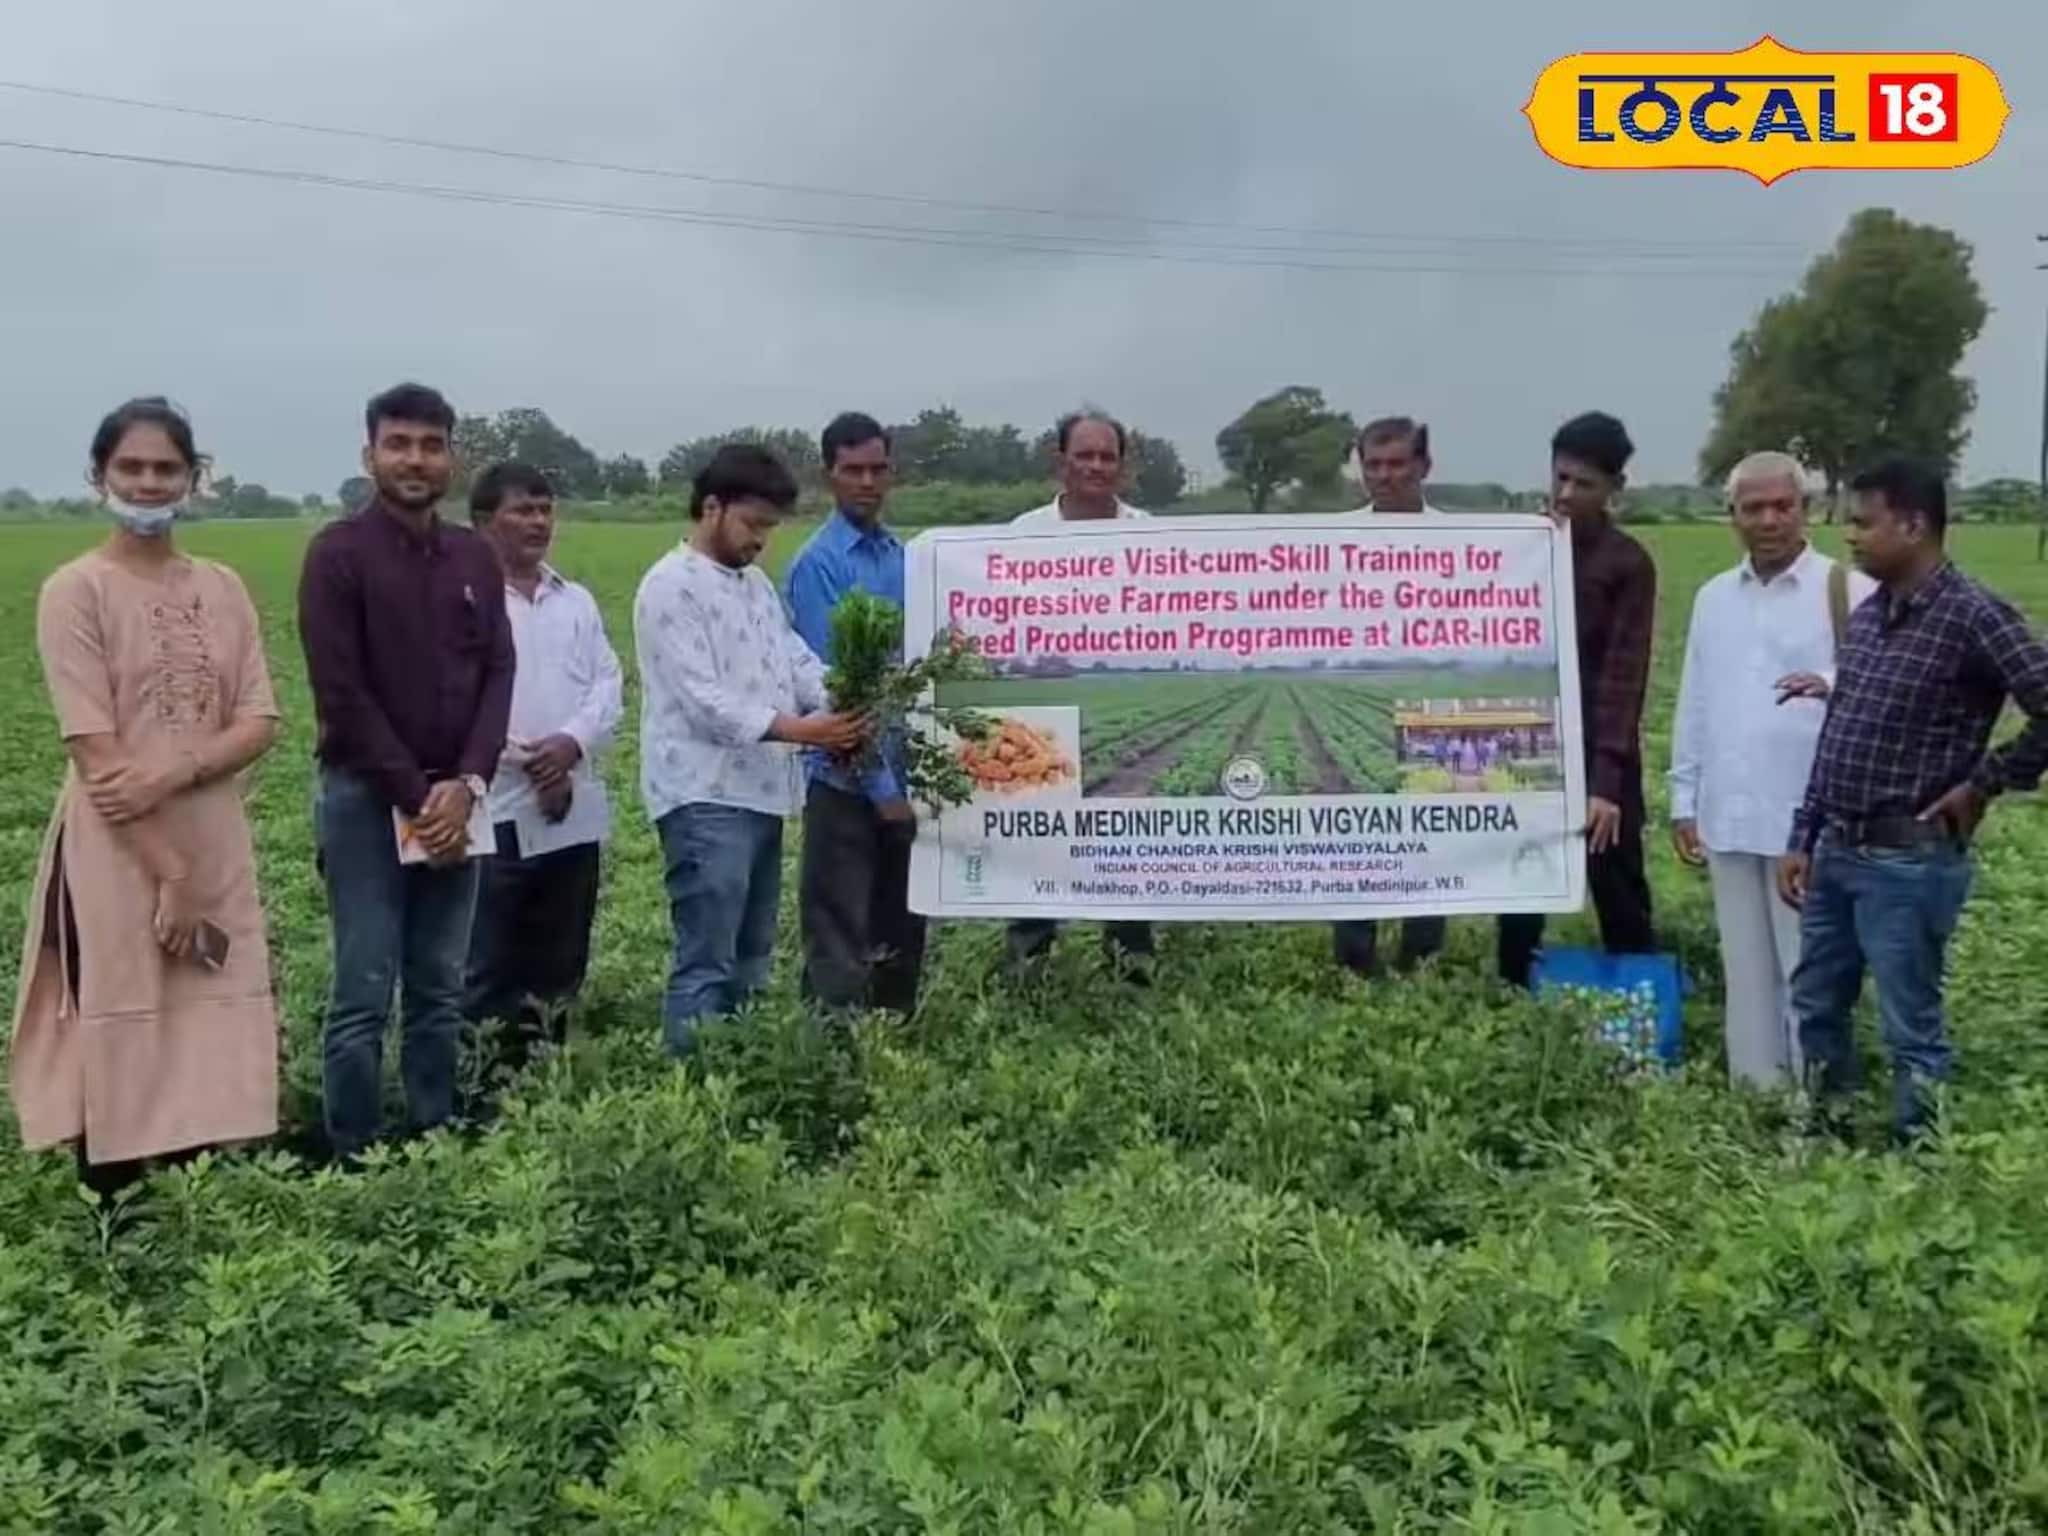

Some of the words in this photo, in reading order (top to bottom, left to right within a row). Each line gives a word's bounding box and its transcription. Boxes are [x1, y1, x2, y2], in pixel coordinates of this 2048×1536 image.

[986, 553, 1115, 585] Exposure
[1124, 545, 1330, 577] Visit-cum-Skill
[1339, 544, 1455, 578] Training
[1465, 545, 1503, 572] for
[949, 587, 1112, 624] Progressive
[1121, 586, 1239, 613] Farmers
[1249, 582, 1329, 611] under
[1340, 582, 1384, 609] the
[1394, 581, 1542, 609] Groundnut
[1026, 624, 1178, 653] Production
[1188, 621, 1353, 656] Programme
[1364, 621, 1390, 647] at
[1402, 617, 1541, 646] ICAR-IIGR
[983, 809, 1067, 838] PURBA
[1074, 808, 1211, 838] MEDINIPUR
[1219, 807, 1301, 836] KRISHI
[1309, 806, 1402, 835] VIGYAN
[1412, 805, 1518, 832] KENDRA
[1070, 844, 1132, 858] BIDHAN
[1136, 843, 1219, 857] CHANDRA
[1223, 843, 1279, 856] KRISHI
[1284, 841, 1428, 855] VISWAVIDYALAYA
[1093, 862, 1138, 874] INDIAN
[1140, 862, 1198, 874] COUNCIL
[1202, 861, 1220, 873] OF
[1329, 859, 1404, 872] RESEARCH
